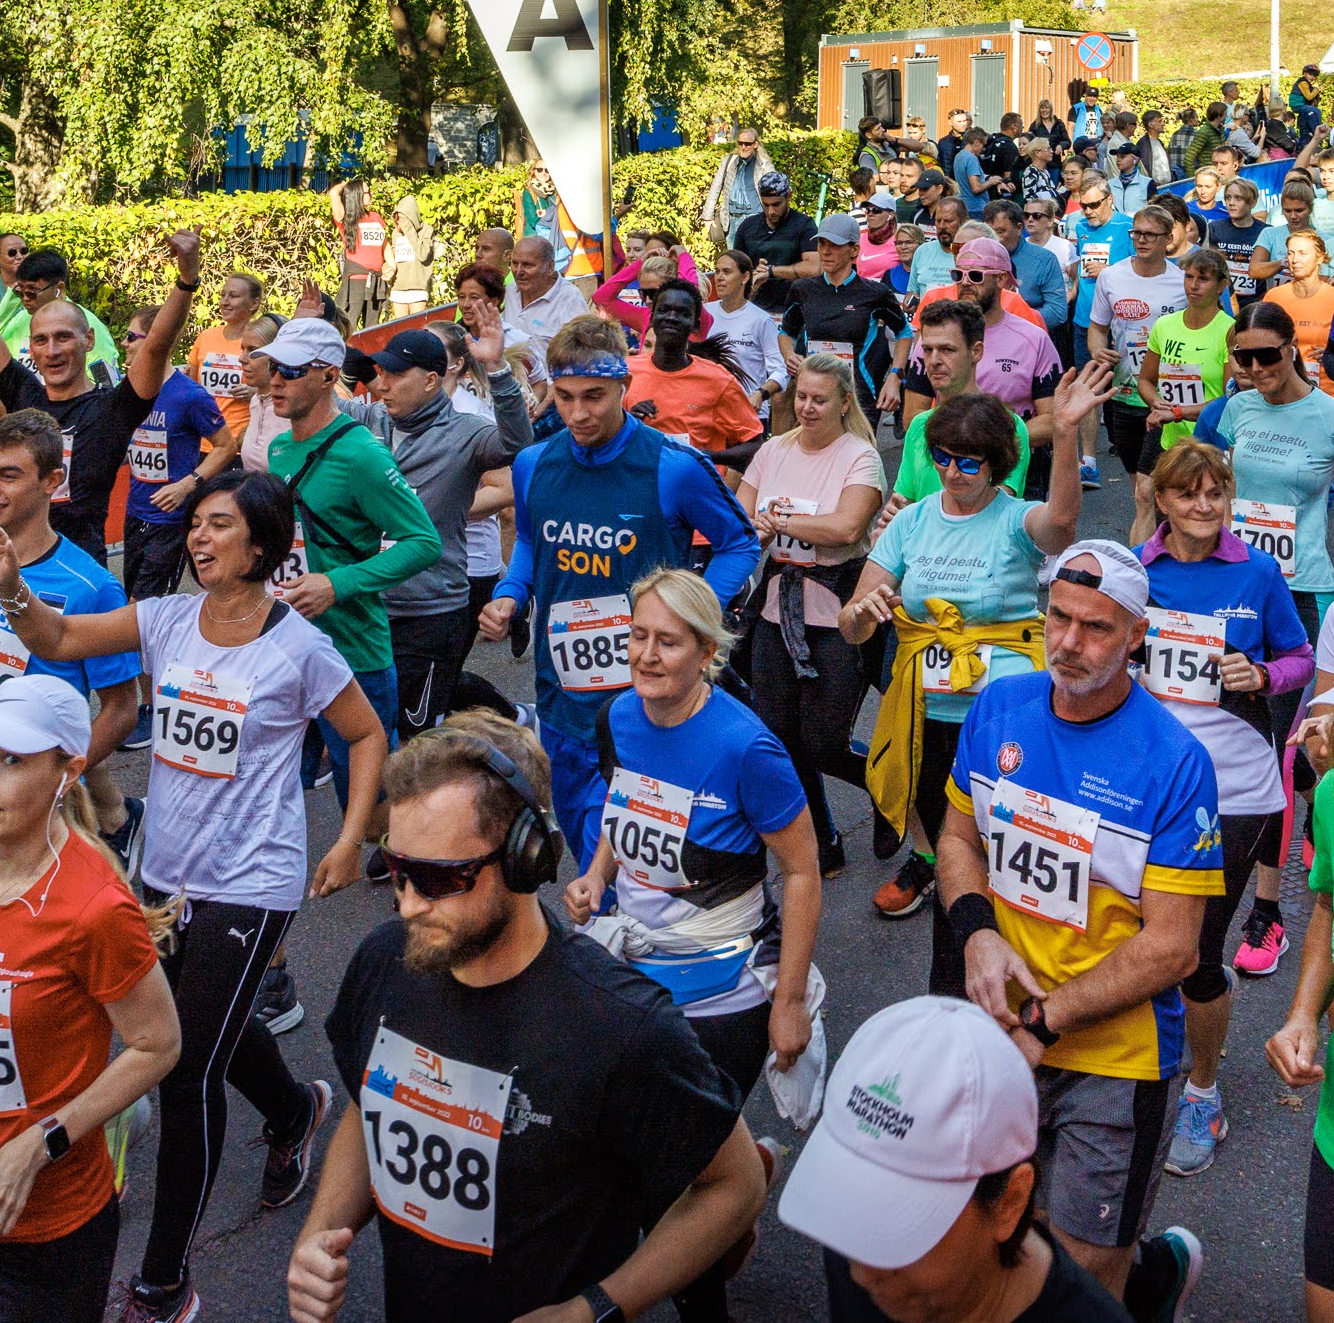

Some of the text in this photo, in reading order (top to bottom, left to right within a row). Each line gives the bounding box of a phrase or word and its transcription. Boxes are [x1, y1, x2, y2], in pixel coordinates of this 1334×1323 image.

[364, 231, 384, 241] 8520
[1231, 276, 1255, 289] 723
[1161, 305, 1175, 314] 96
[1164, 339, 1186, 356] WE
[1001, 363, 1011, 372] 65
[201, 371, 240, 389] 1949
[140, 412, 166, 429] NIA
[1240, 429, 1309, 450] Aeg ei peatu,
[1243, 441, 1292, 458] liigume!
[128, 449, 166, 471] 1446
[543, 520, 636, 555] CARGO
[557, 549, 611, 577] SON
[936, 556, 947, 569] ei
[947, 557, 988, 572] peatu,
[1205, 636, 1215, 646] 10
[7, 656, 16, 667] 10
[553, 634, 630, 673] 1885
[1146, 644, 1220, 686] 1154
[226, 701, 237, 712] 10
[157, 706, 239, 755] 1569
[1082, 771, 1110, 786] Svenska
[1078, 789, 1134, 812] www.addison.se
[1080, 780, 1144, 807] Addisonföreningen
[670, 813, 679, 825] 10
[603, 817, 683, 874] 1055
[1068, 836, 1079, 847] 10
[990, 832, 1081, 902] 1451
[849, 1084, 915, 1129] STOCKHOLM
[467, 1113, 482, 1130] 10
[847, 1097, 909, 1141] MARATHON
[363, 1110, 495, 1212] 1388
